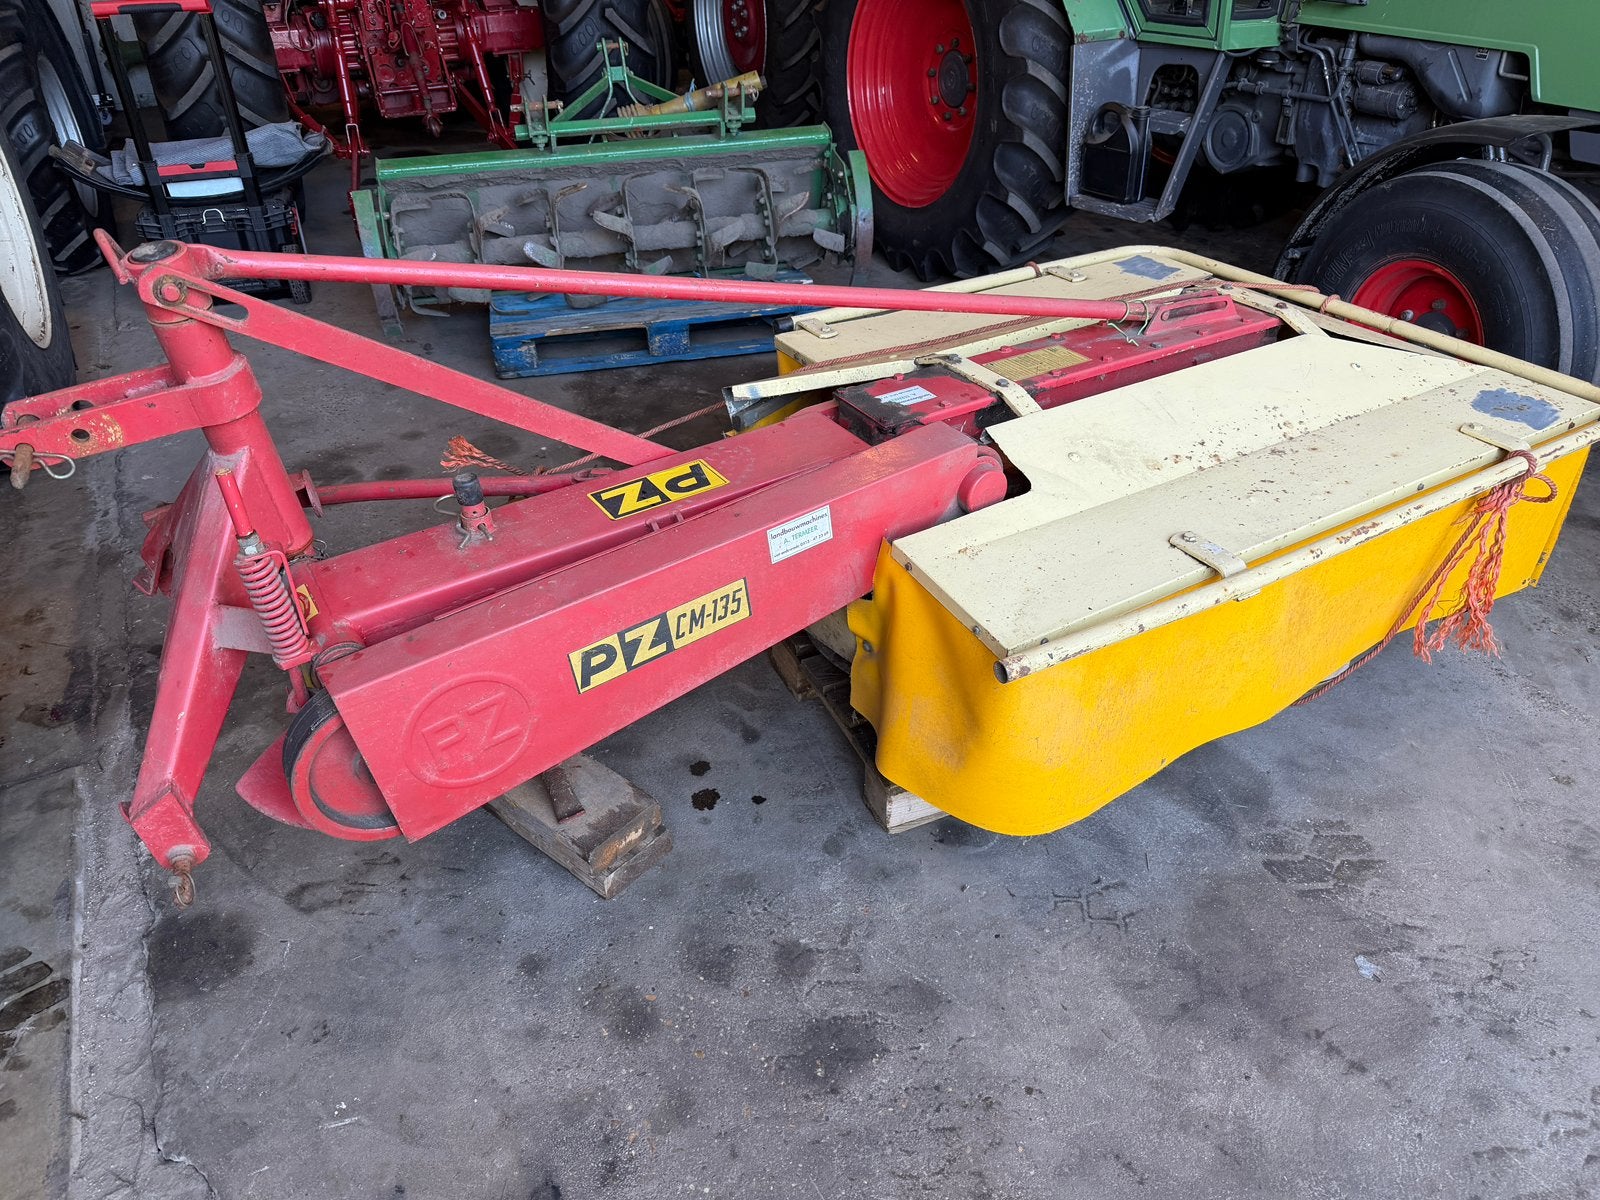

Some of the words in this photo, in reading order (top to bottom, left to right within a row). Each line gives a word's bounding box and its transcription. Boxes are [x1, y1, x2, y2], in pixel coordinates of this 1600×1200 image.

[601, 463, 711, 515] PZ
[770, 513, 828, 540] landbouwmachines
[792, 525, 819, 541] TERMEER
[580, 617, 667, 689] PZ
[675, 588, 742, 639] CM-135
[422, 692, 521, 772] PZ
